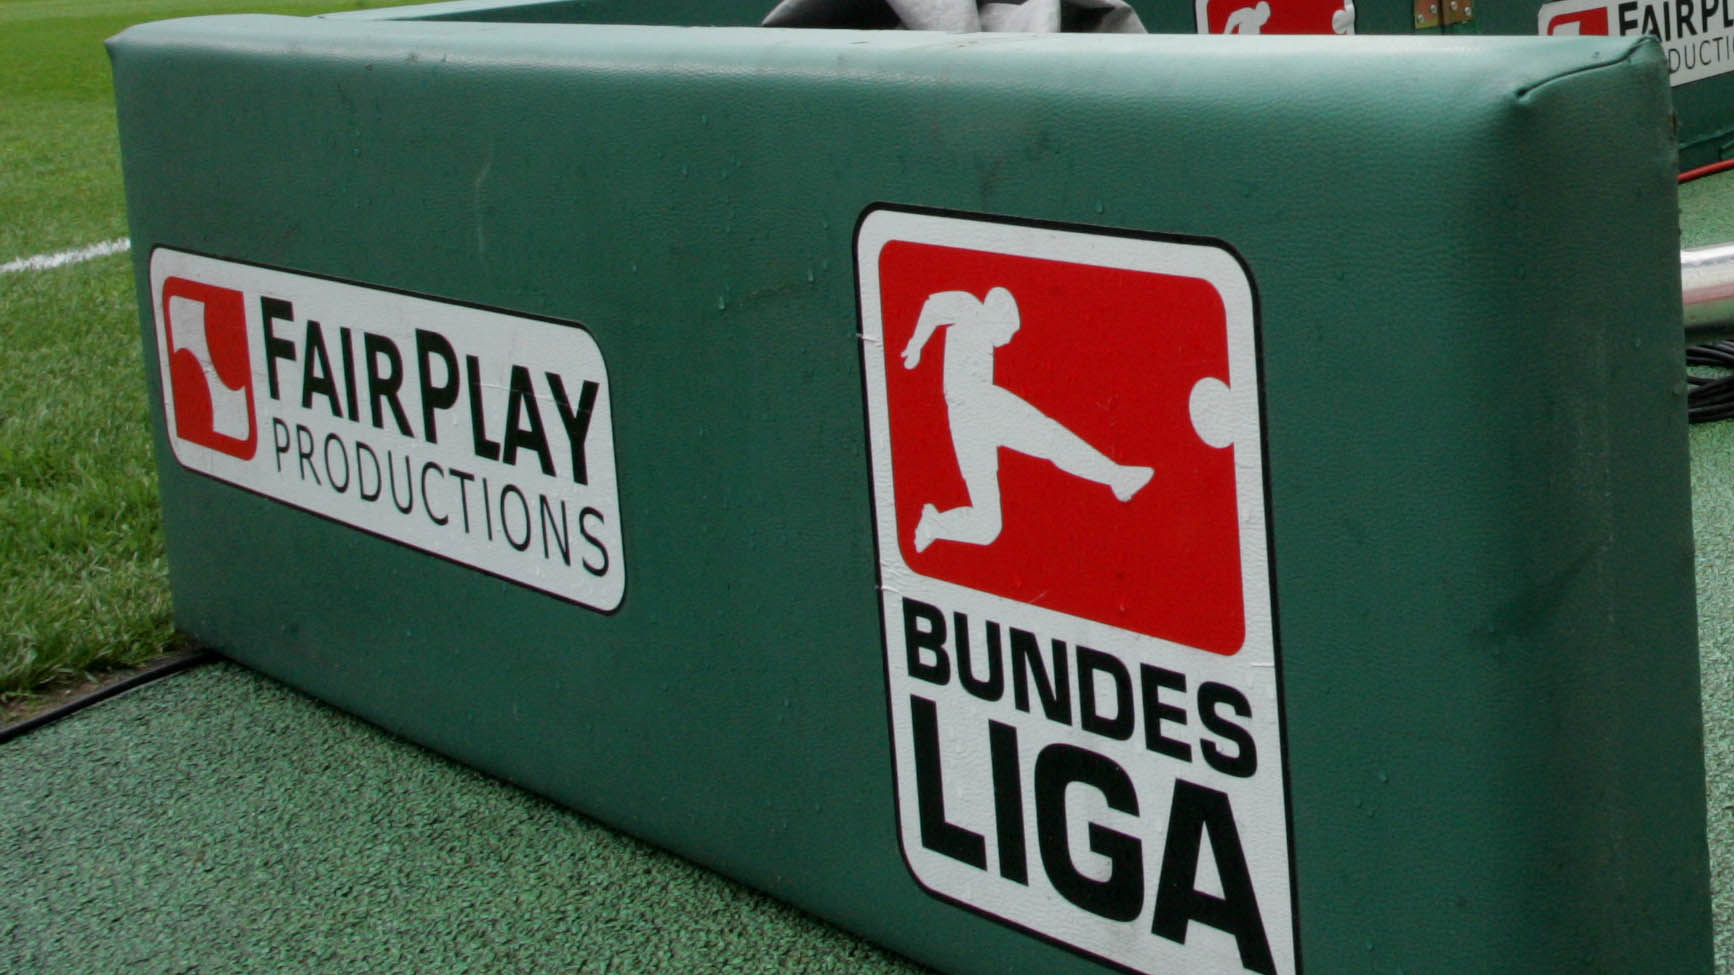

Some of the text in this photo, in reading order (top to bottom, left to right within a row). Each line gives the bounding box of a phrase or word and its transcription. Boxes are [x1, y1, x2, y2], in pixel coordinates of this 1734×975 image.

[260, 295, 600, 486] FAIRPLAY
[272, 417, 609, 577] PRODUCTIONS
[901, 595, 1258, 779] BUNDES
[910, 694, 1277, 975] LIGA
